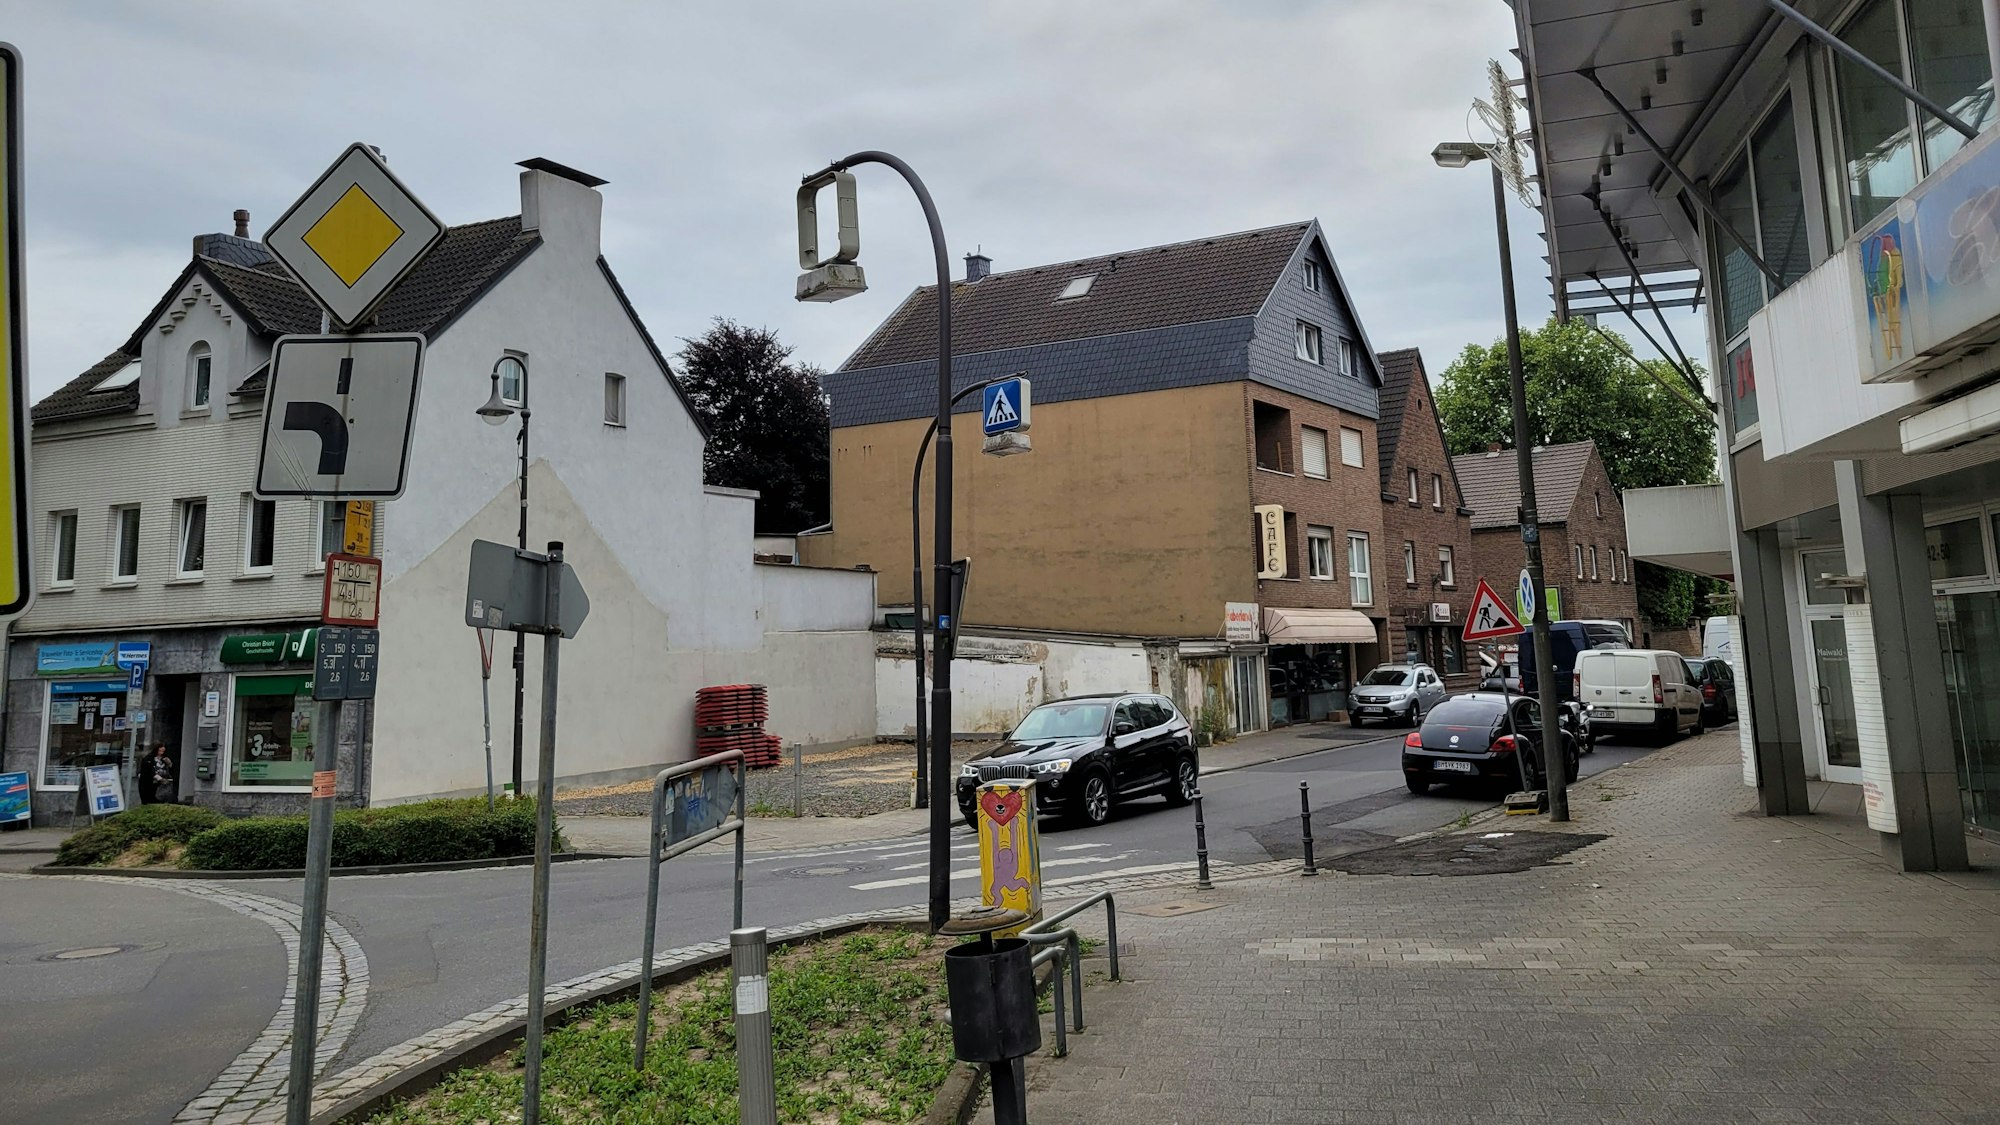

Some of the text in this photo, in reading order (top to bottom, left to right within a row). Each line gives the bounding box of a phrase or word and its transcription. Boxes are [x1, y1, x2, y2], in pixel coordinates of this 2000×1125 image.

[320, 643, 346, 653] S 150
[351, 643, 376, 654] S 150
[133, 664, 142, 686] P
[251, 733, 264, 757] 3
